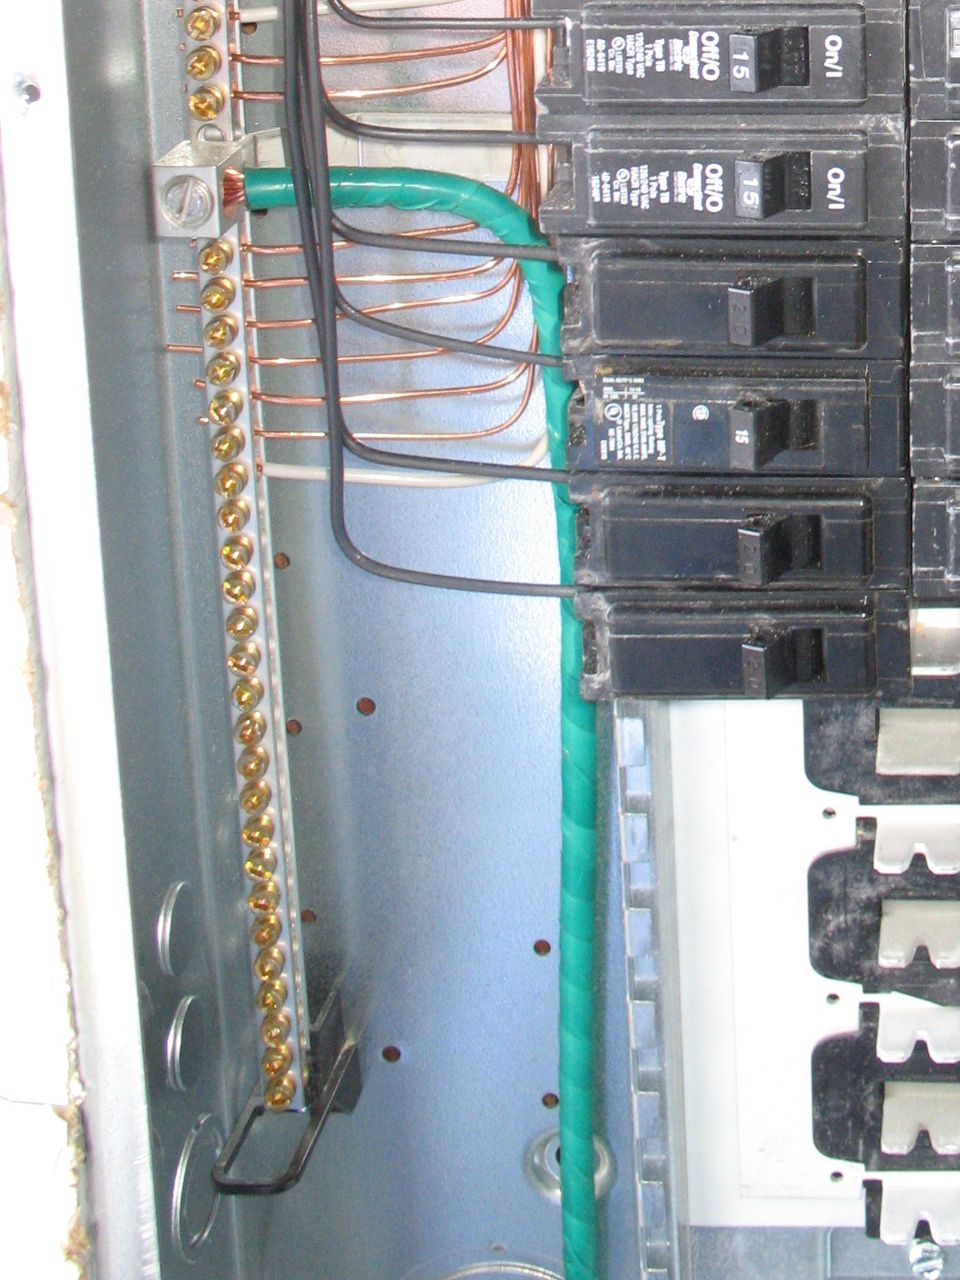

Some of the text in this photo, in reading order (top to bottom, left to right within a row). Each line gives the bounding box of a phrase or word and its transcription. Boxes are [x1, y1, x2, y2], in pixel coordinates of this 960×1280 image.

[732, 51, 750, 79] 15
[743, 177, 760, 206] 15
[735, 429, 749, 444] 15
